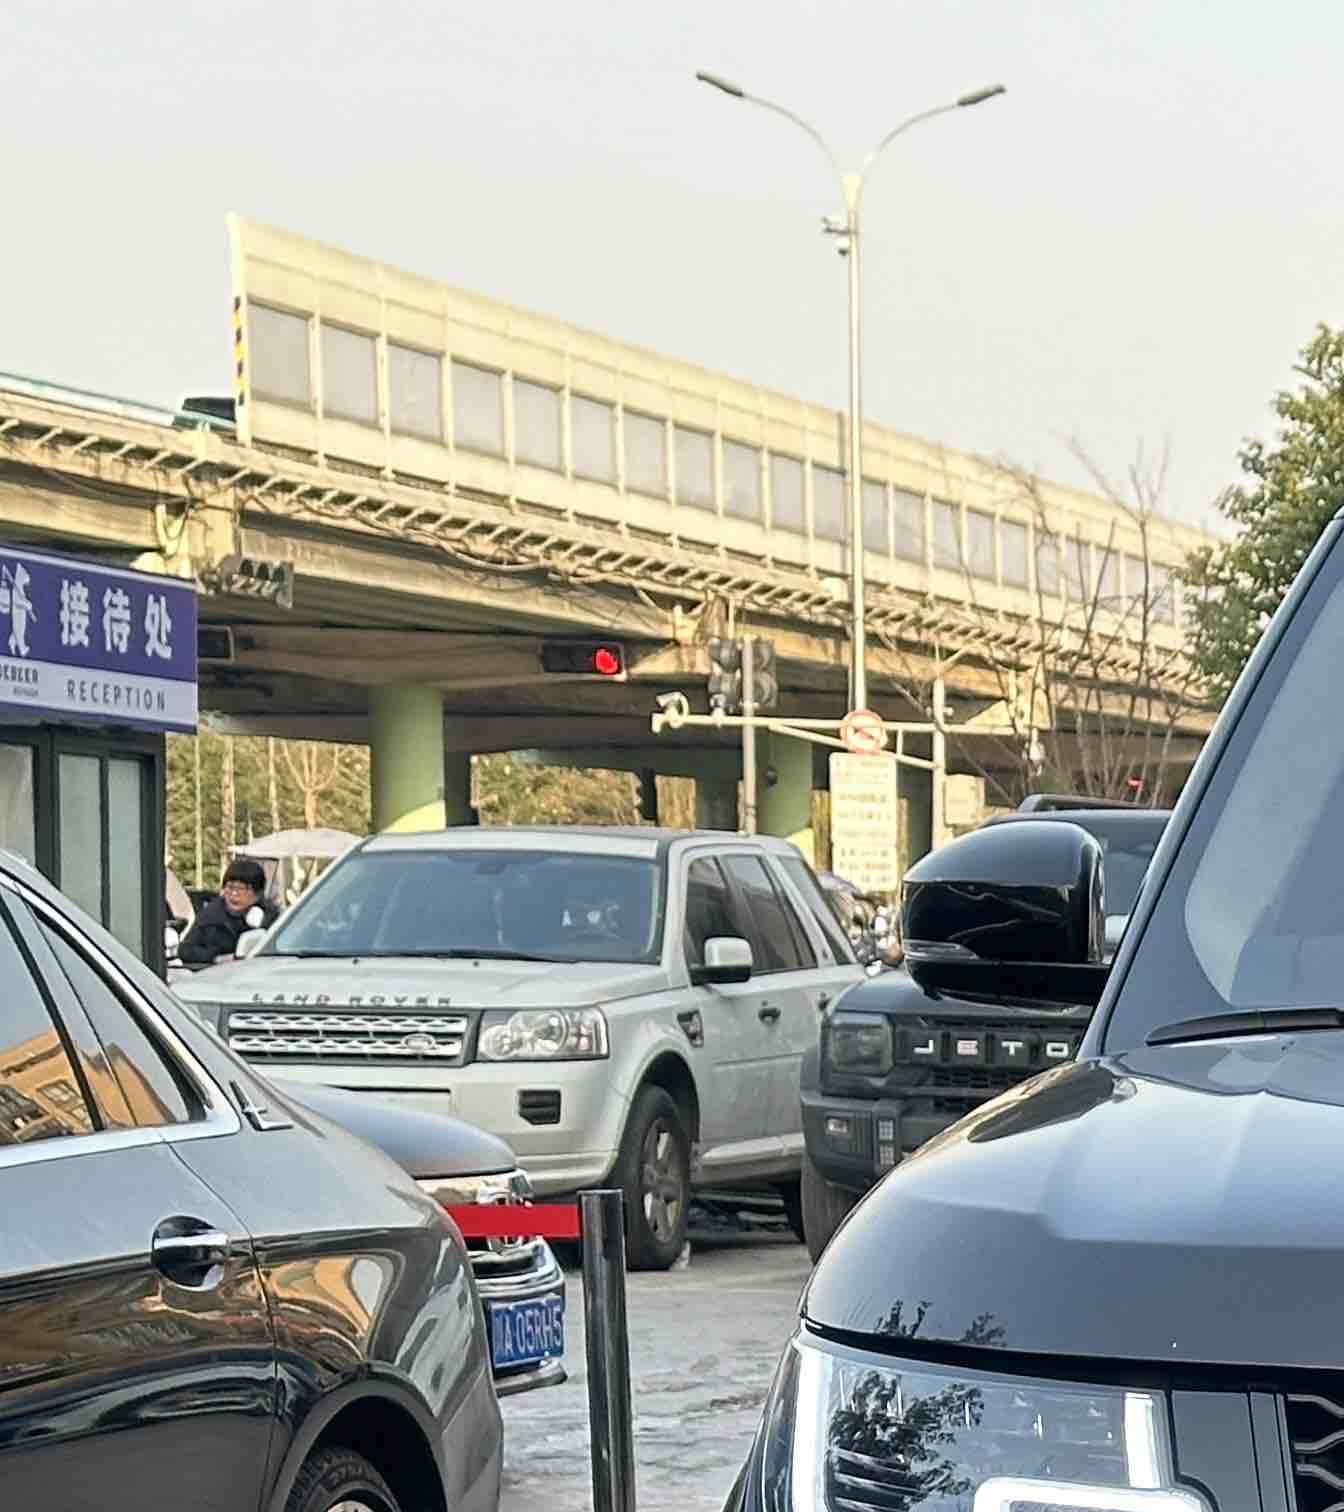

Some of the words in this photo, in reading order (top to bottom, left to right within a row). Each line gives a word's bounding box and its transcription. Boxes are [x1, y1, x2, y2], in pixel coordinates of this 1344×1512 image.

[60, 578, 173, 660] 接待处
[66, 679, 166, 713] RECEPTION
[252, 992, 331, 1005] LAND
